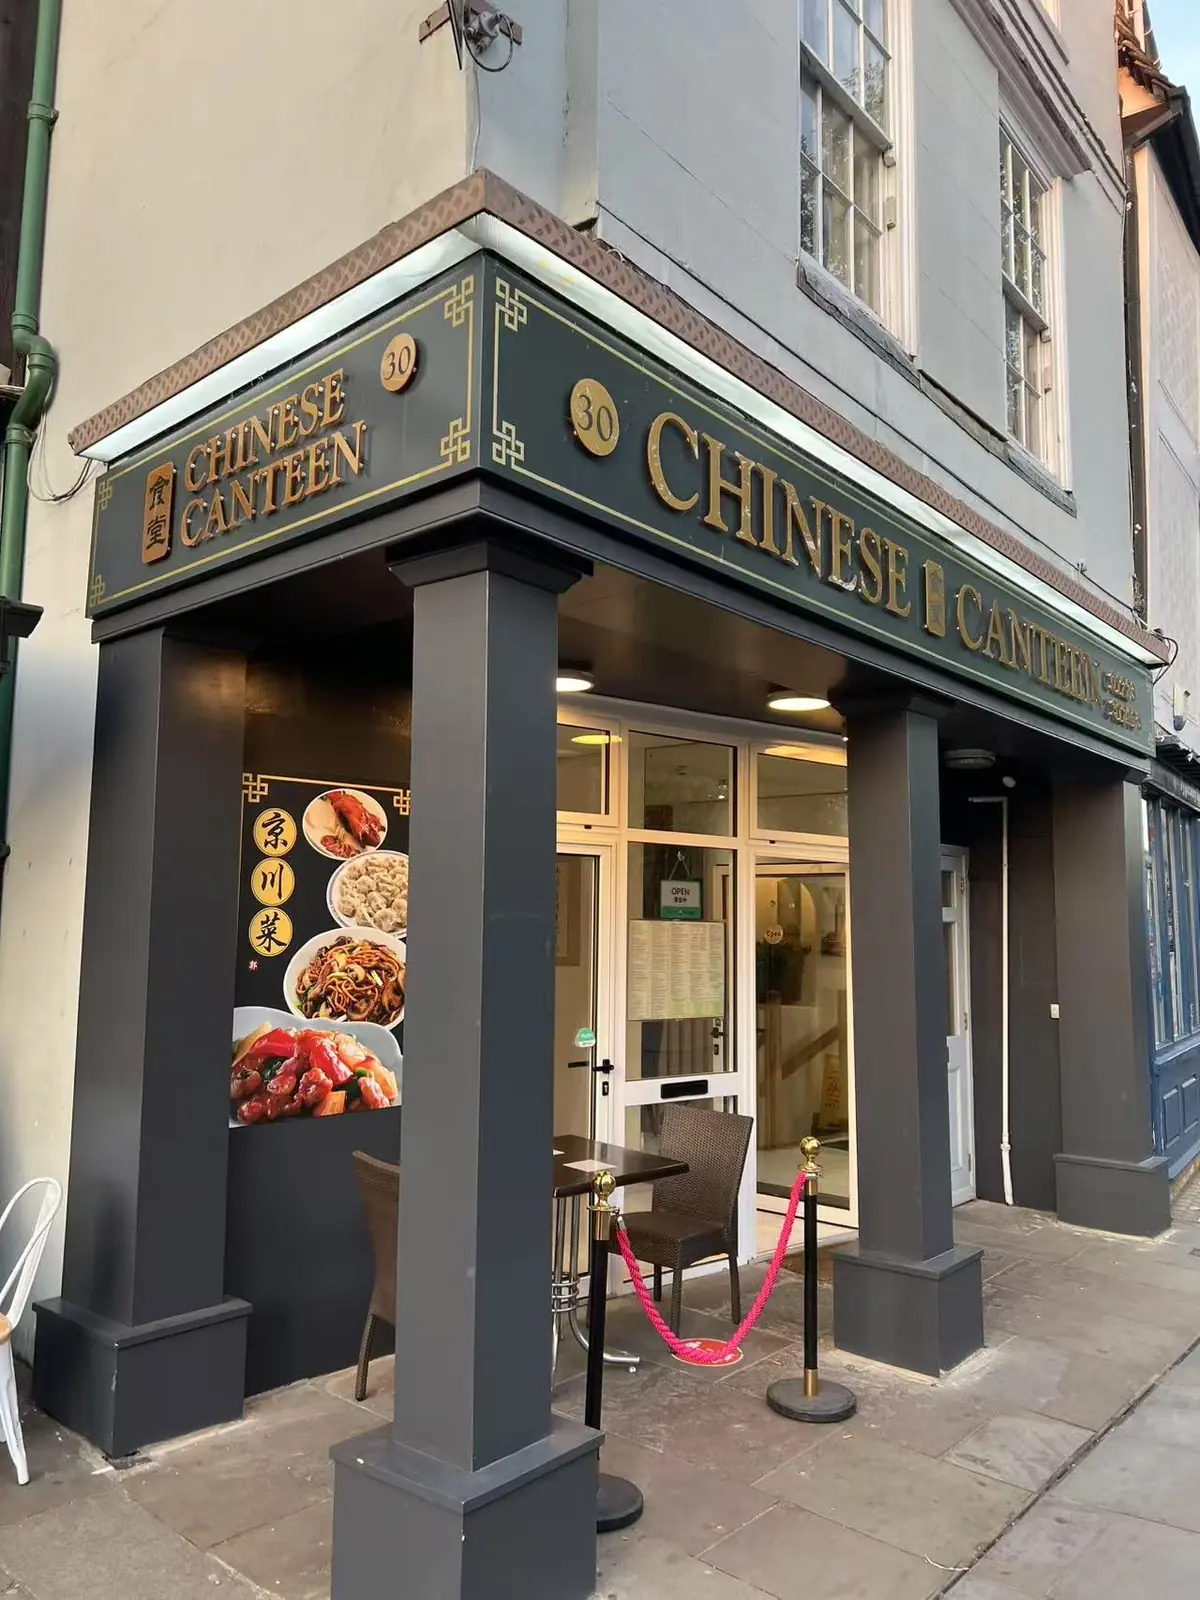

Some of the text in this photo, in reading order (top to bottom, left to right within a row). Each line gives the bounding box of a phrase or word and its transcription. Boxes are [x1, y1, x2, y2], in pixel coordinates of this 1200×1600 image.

[385, 345, 411, 380] 30
[184, 368, 346, 493] CHINESE
[577, 394, 614, 442] 30
[145, 475, 171, 550] 食堂
[179, 420, 367, 548] CANTEEN
[647, 411, 1102, 706] CHINESE CANTEEN
[255, 811, 289, 953] 京川菜
[671, 887, 690, 896] OPEN
